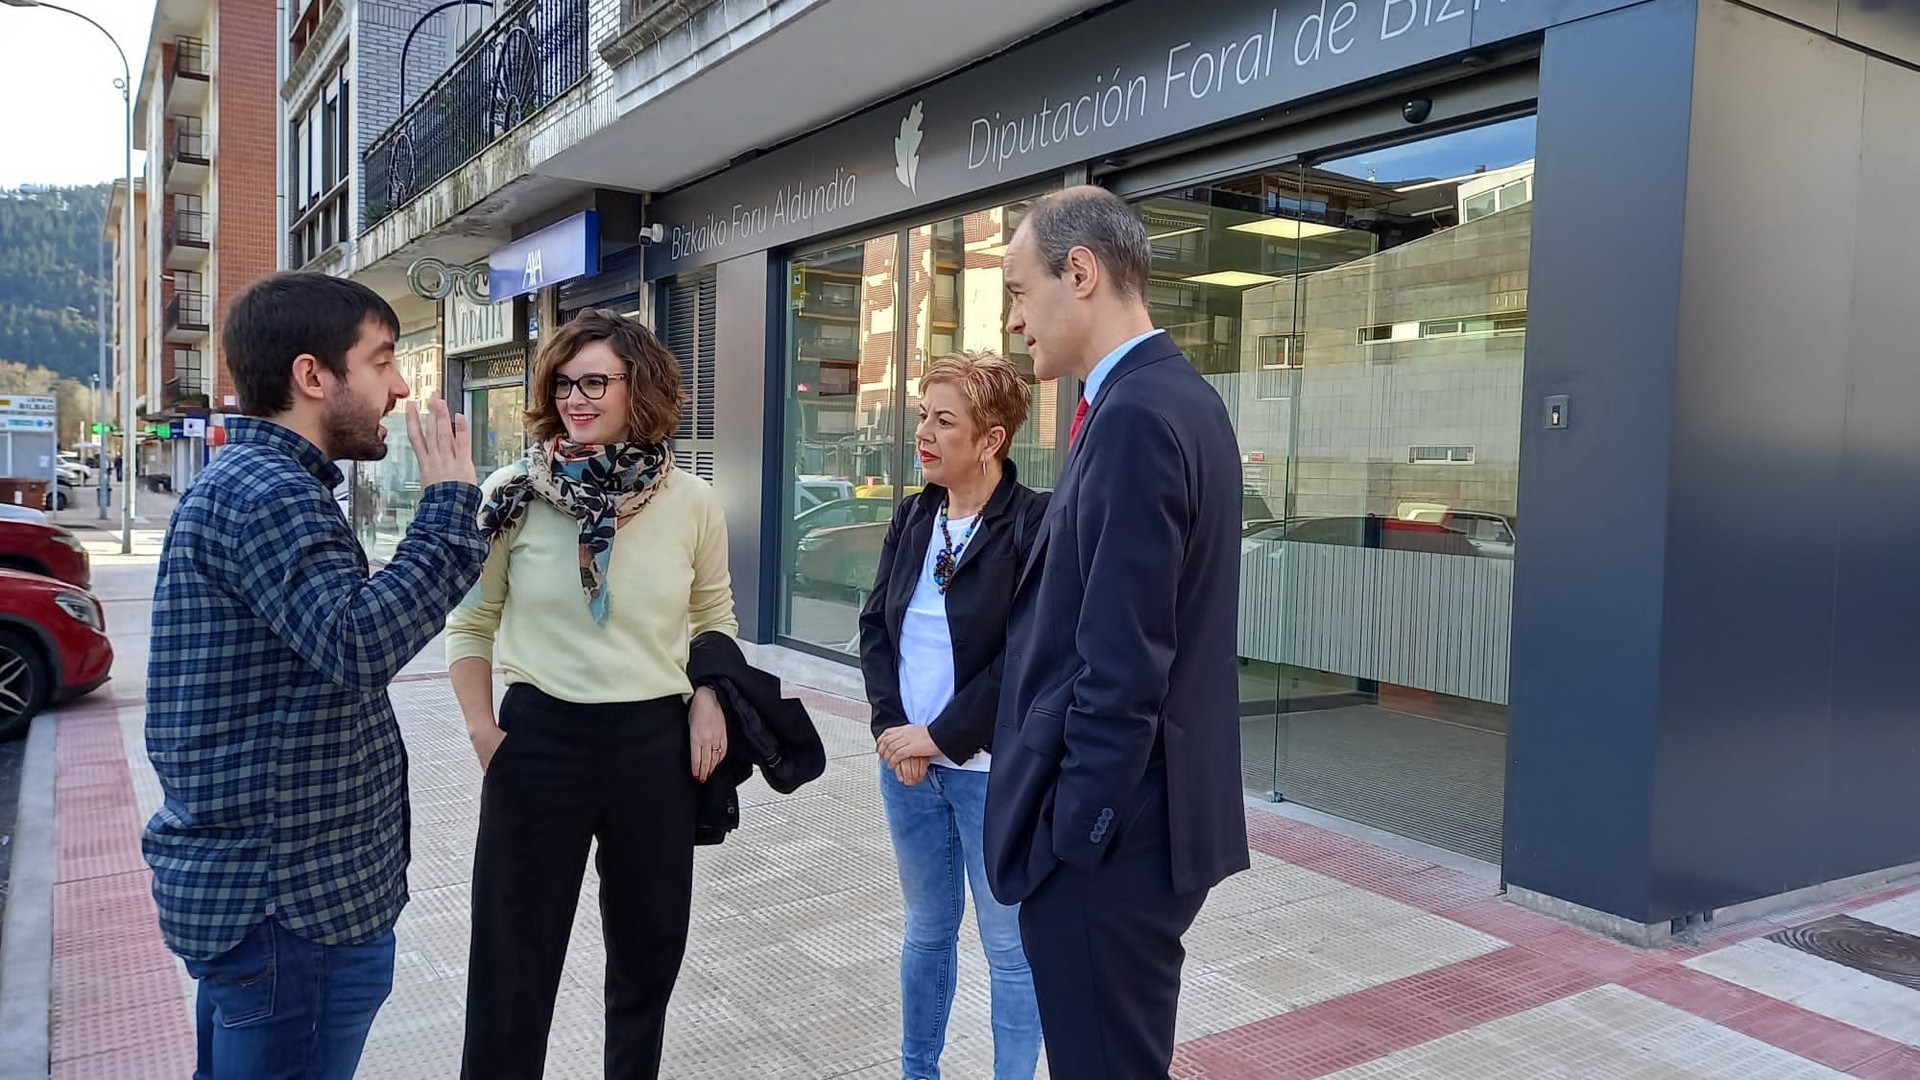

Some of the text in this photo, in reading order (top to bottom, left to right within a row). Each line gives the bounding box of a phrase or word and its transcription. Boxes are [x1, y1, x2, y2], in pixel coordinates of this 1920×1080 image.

[968, 68, 1146, 173] Diputación
[1164, 9, 1277, 109] Foral
[1294, 0, 1357, 65] de
[671, 167, 856, 260] Bizkaiko Foru Aldundia
[522, 249, 543, 289] AXA
